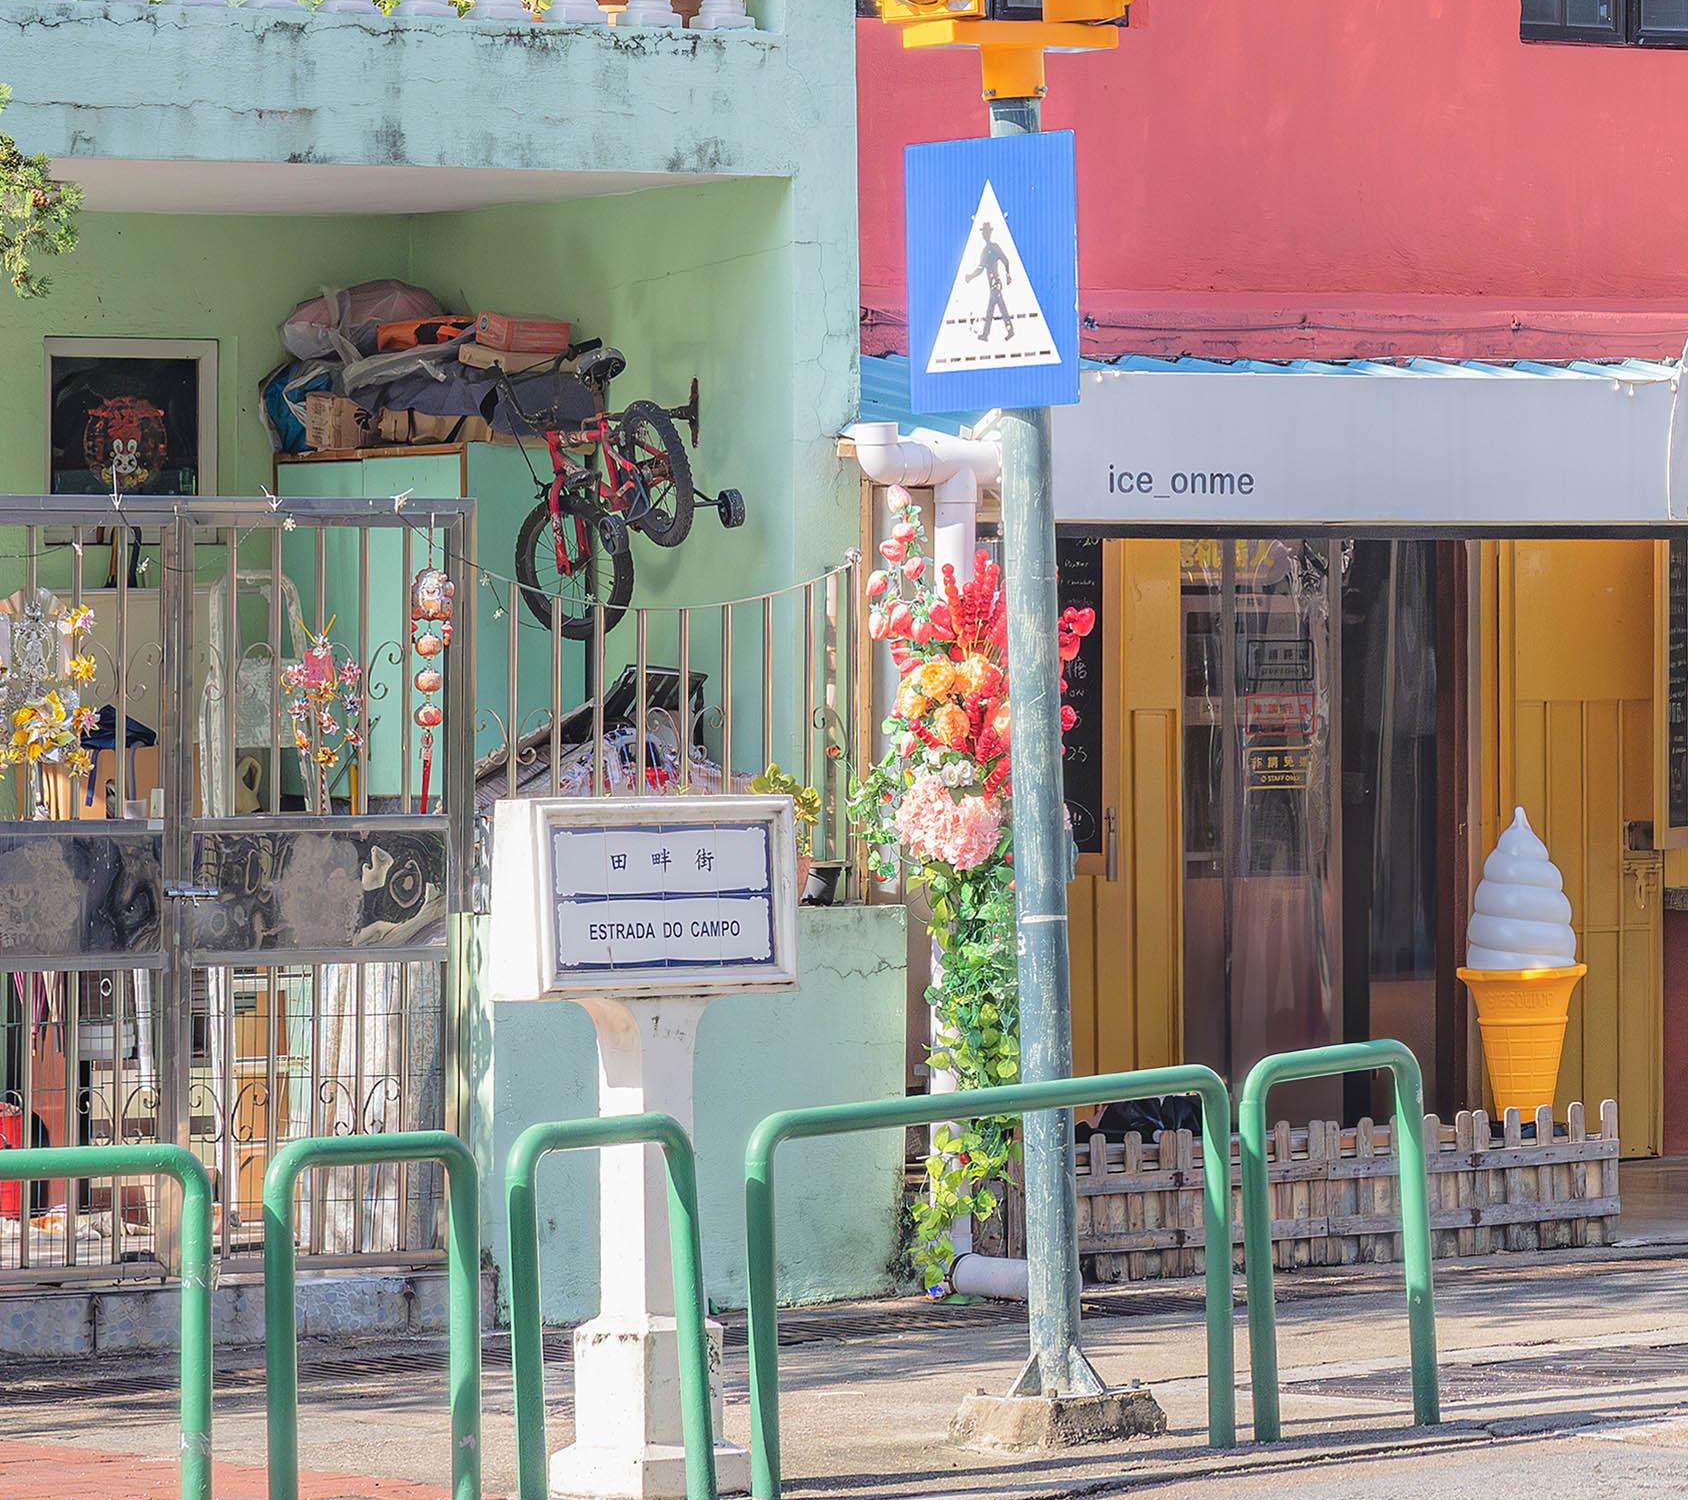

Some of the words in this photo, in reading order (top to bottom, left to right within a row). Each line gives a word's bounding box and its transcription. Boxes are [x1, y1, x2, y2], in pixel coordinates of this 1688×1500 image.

[1109, 464, 1254, 499] ice_onme
[609, 848, 714, 873] 田畔街
[589, 920, 656, 941] ESTRADA
[663, 920, 684, 938] DO
[690, 919, 741, 937] CAMPO
